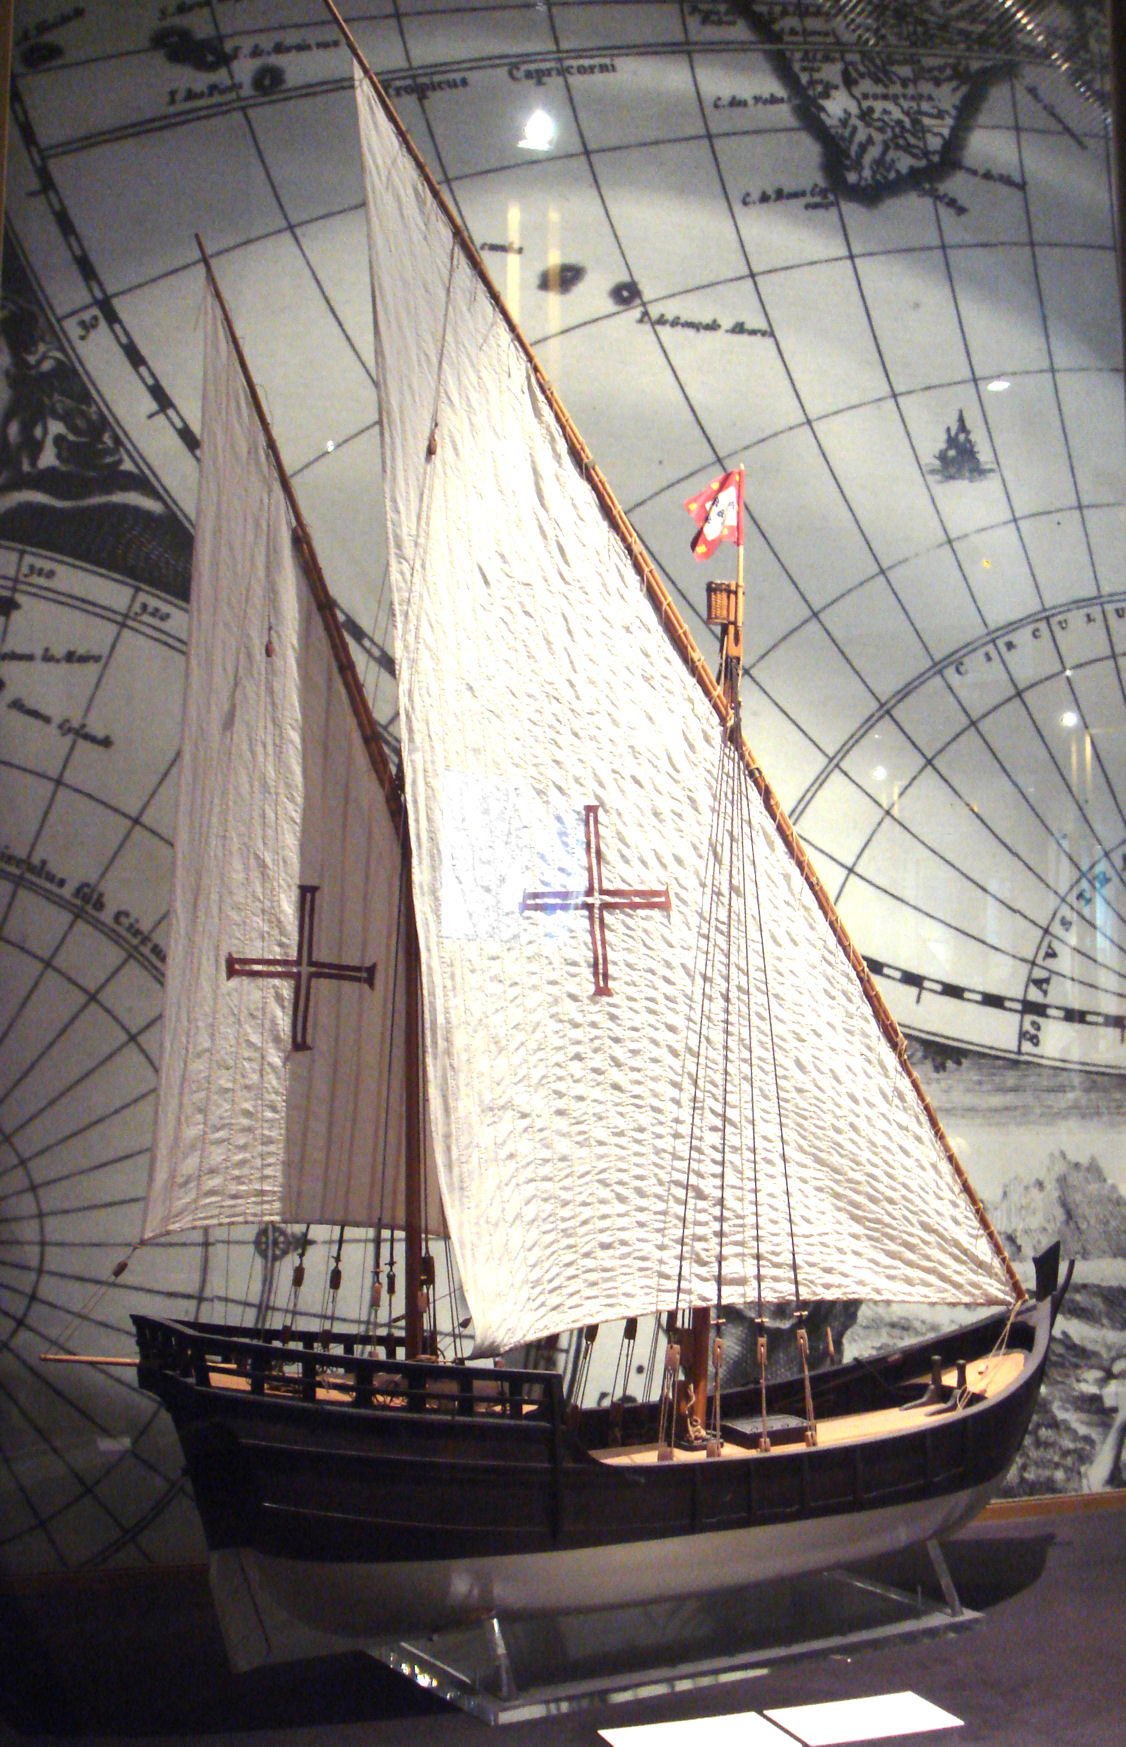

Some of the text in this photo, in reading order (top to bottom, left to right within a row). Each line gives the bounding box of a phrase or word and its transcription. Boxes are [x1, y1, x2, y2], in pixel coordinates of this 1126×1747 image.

[383, 58, 617, 100] Tropicus Capricorni
[77, 314, 99, 341] 30
[24, 564, 56, 579] 310
[134, 602, 171, 622] 320
